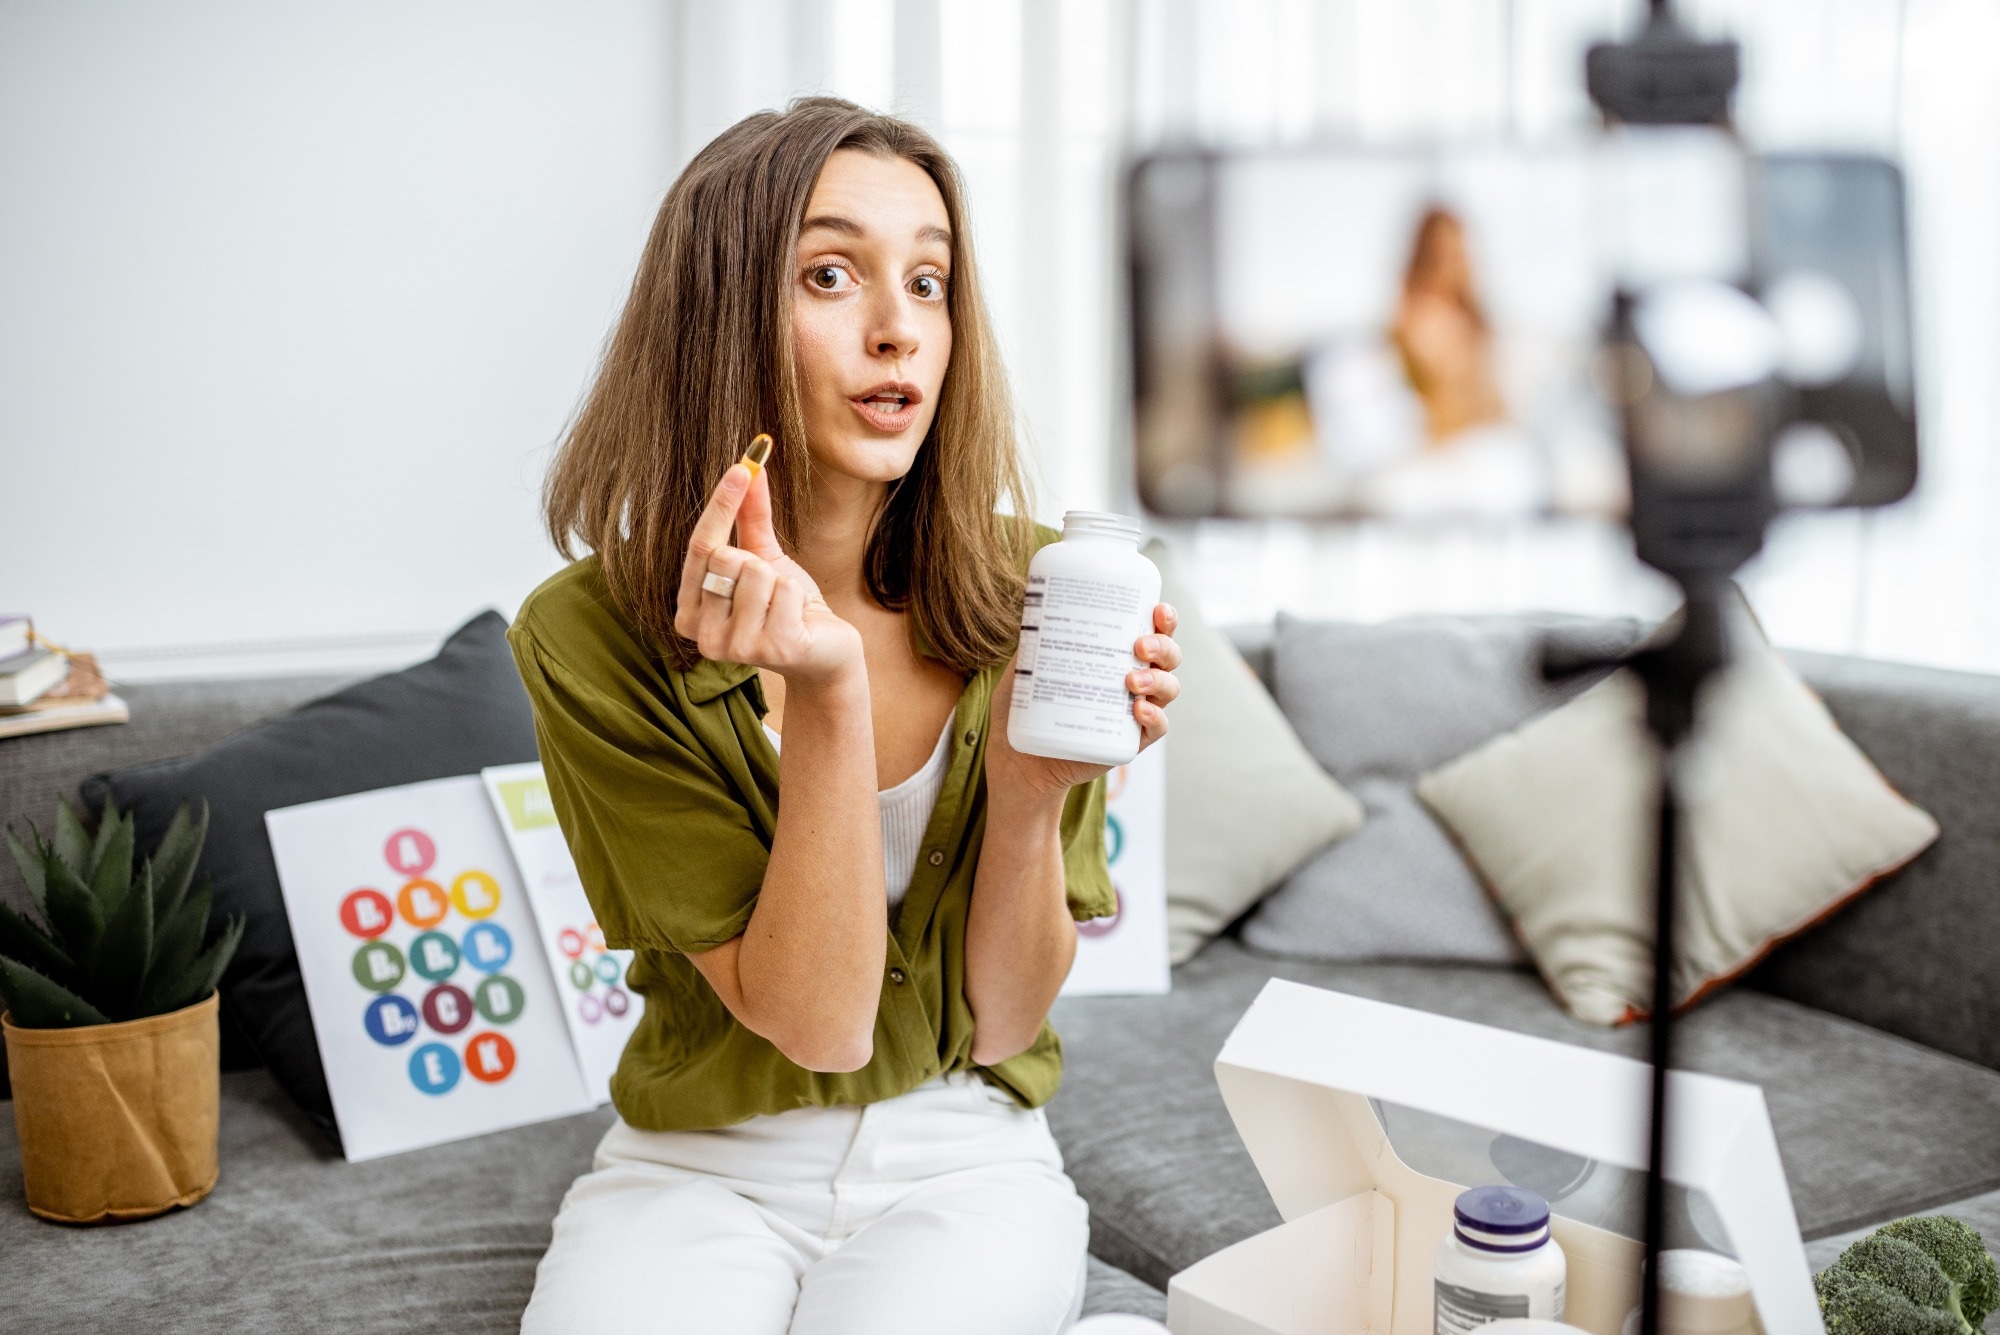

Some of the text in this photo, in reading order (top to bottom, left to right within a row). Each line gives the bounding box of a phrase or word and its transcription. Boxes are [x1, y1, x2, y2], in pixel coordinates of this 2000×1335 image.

[398, 836, 424, 869] A
[434, 991, 460, 1025] C
[423, 1039, 504, 1085] E K
